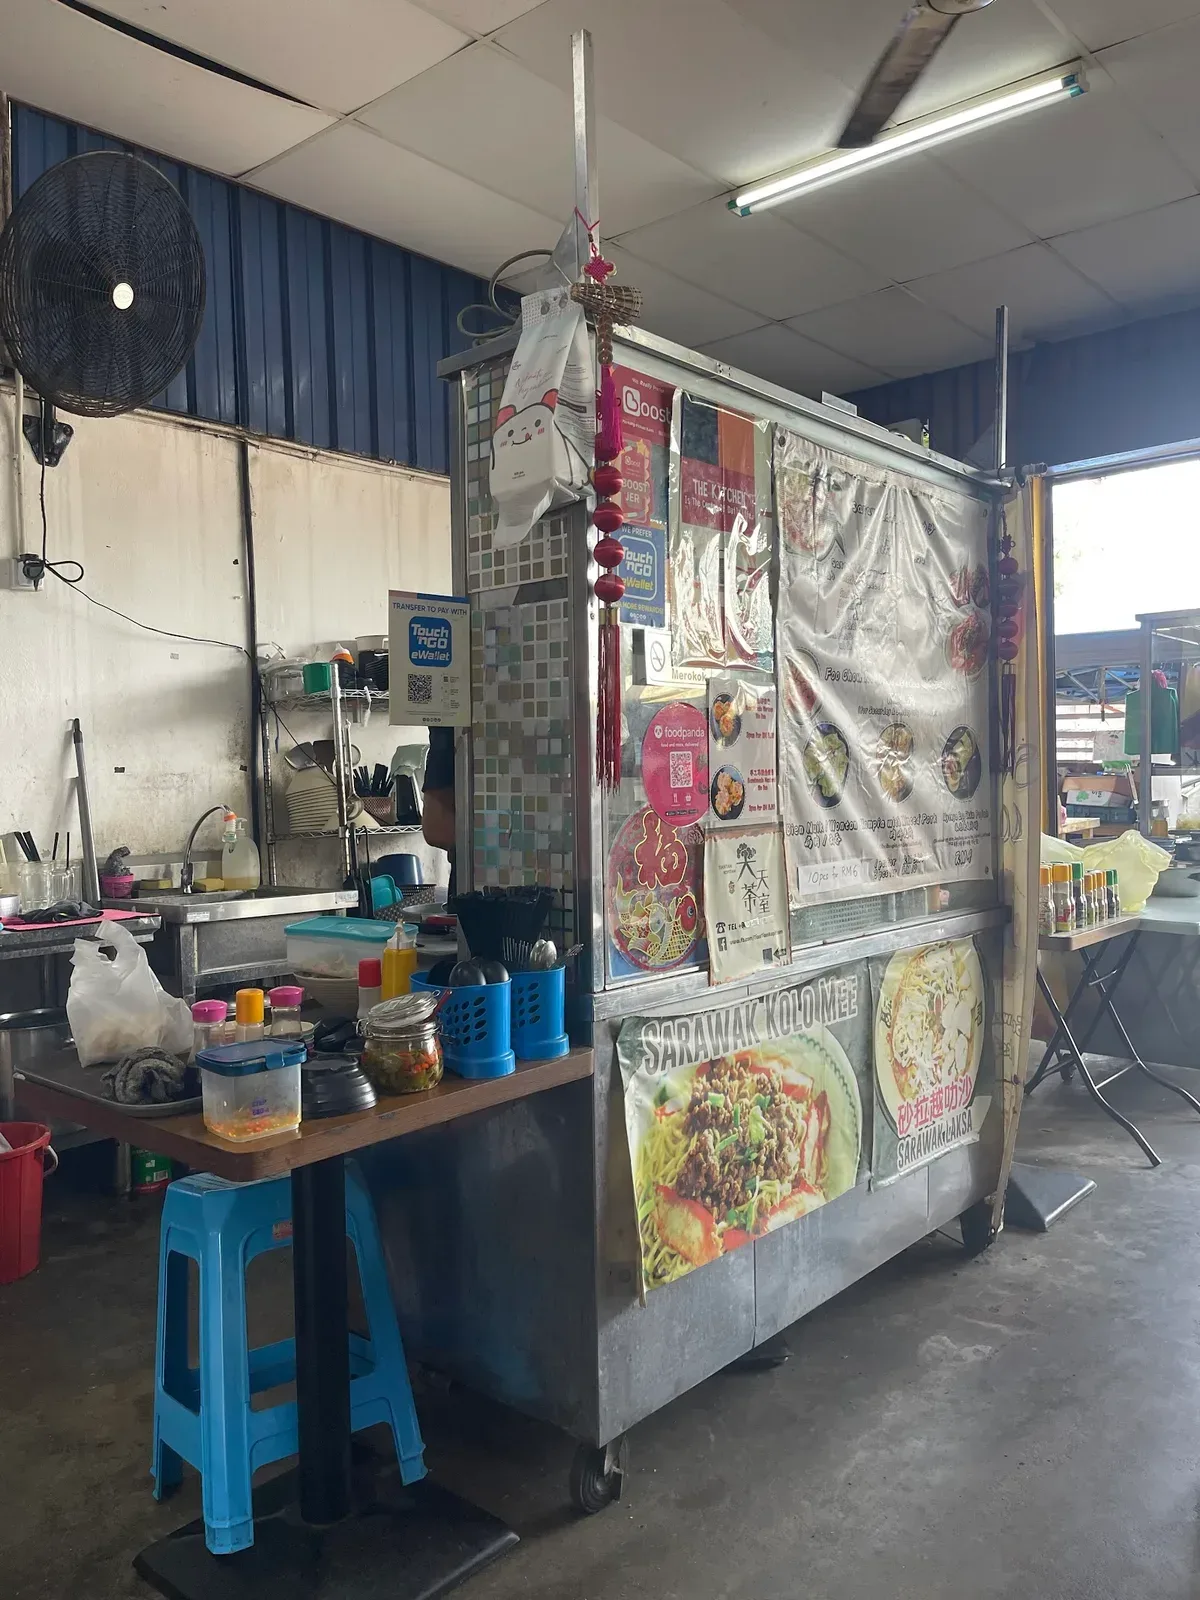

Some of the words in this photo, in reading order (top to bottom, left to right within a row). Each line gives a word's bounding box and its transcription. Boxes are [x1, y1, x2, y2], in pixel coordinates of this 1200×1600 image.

[622, 385, 671, 424] Boost
[623, 478, 648, 493] BOOST
[692, 478, 709, 497] THE
[625, 492, 640, 504] JER
[632, 527, 652, 538] PREFER
[622, 546, 653, 565] Touch
[393, 602, 426, 613] TRANSFER
[427, 604, 436, 613] TO
[437, 606, 449, 615] PAY
[450, 608, 468, 616] WITH
[411, 623, 449, 639] Touch
[411, 650, 450, 662] eWallet
[671, 668, 707, 682] Merokok
[664, 725, 705, 740] foodpanda
[841, 865, 858, 878] RM6
[728, 923, 738, 931] TEL
[643, 1001, 761, 1076] SARAWAK
[765, 987, 816, 1040] KOLO
[819, 976, 858, 1025] MEE
[897, 1075, 973, 1136] 砂拉越叻沙
[898, 1123, 945, 1169] SARAWAK
[944, 1109, 973, 1143] LAKSA
